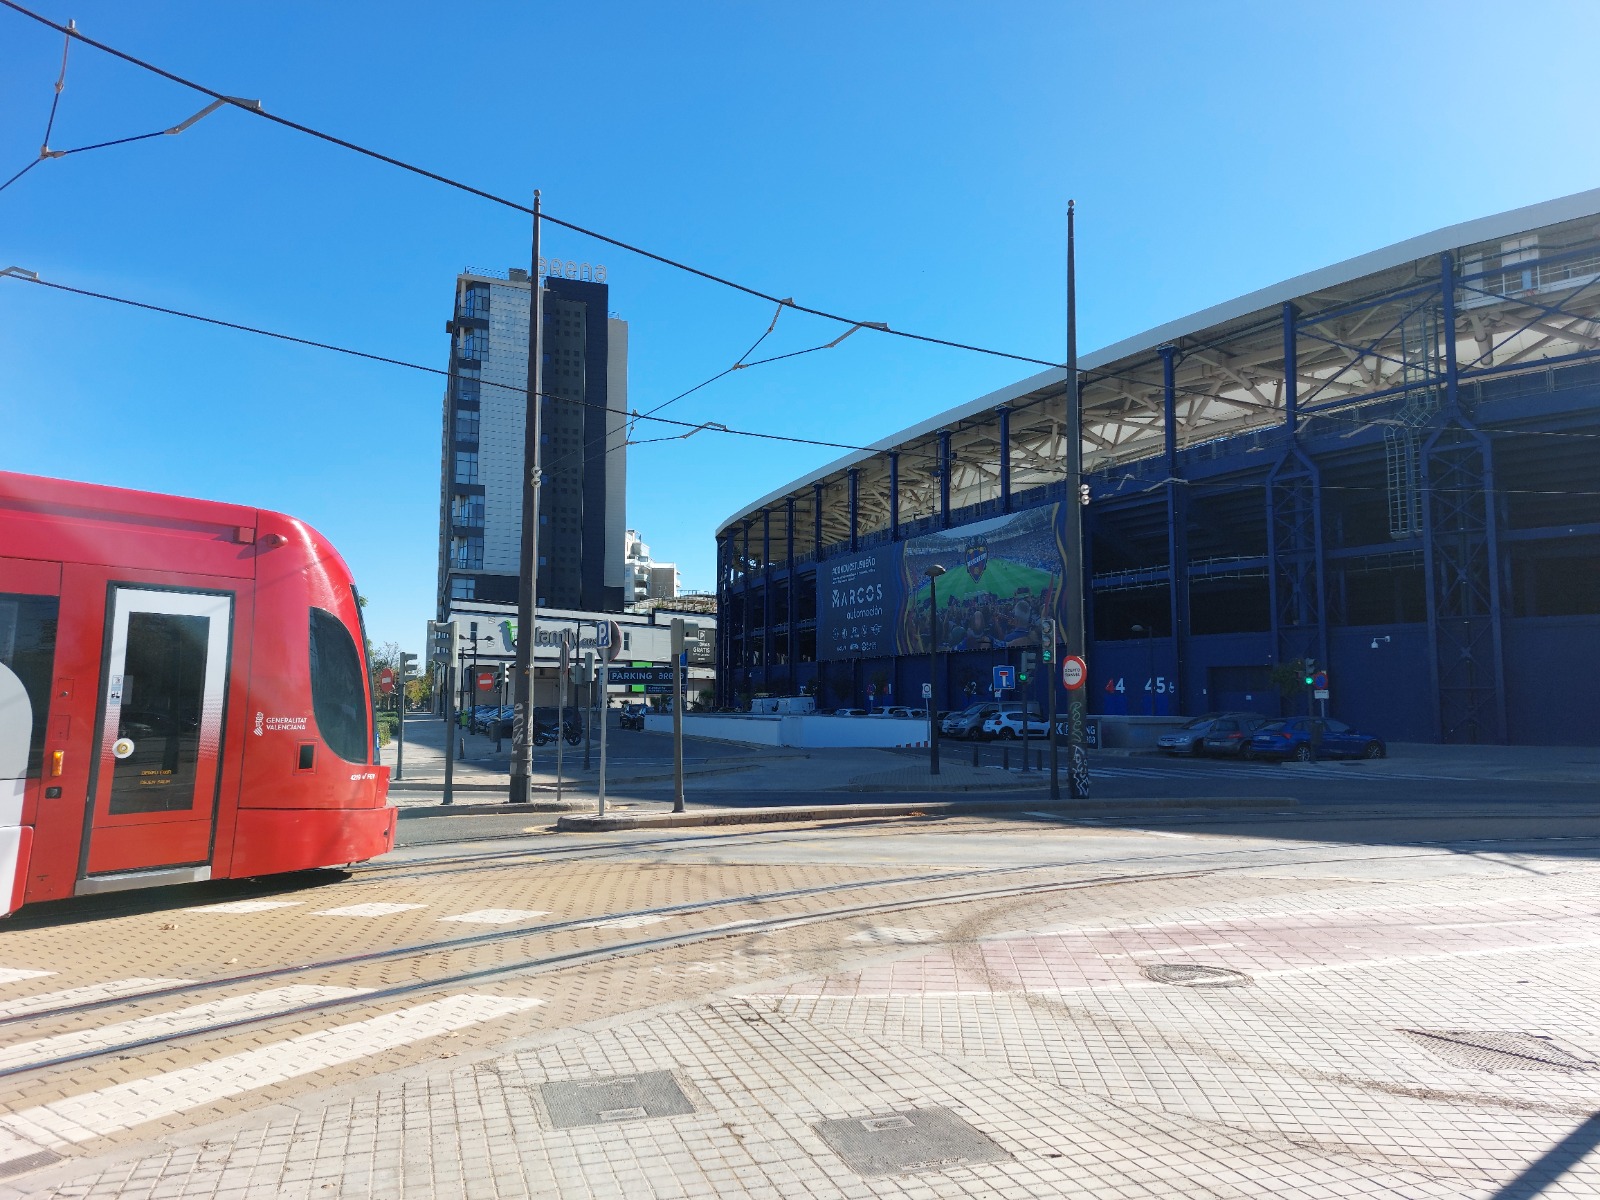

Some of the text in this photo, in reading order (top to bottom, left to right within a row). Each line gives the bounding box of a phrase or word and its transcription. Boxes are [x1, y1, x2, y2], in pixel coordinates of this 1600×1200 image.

[832, 583, 883, 608] MARCOS
[612, 672, 653, 681] PARKING
[1144, 676, 1166, 694] 45
